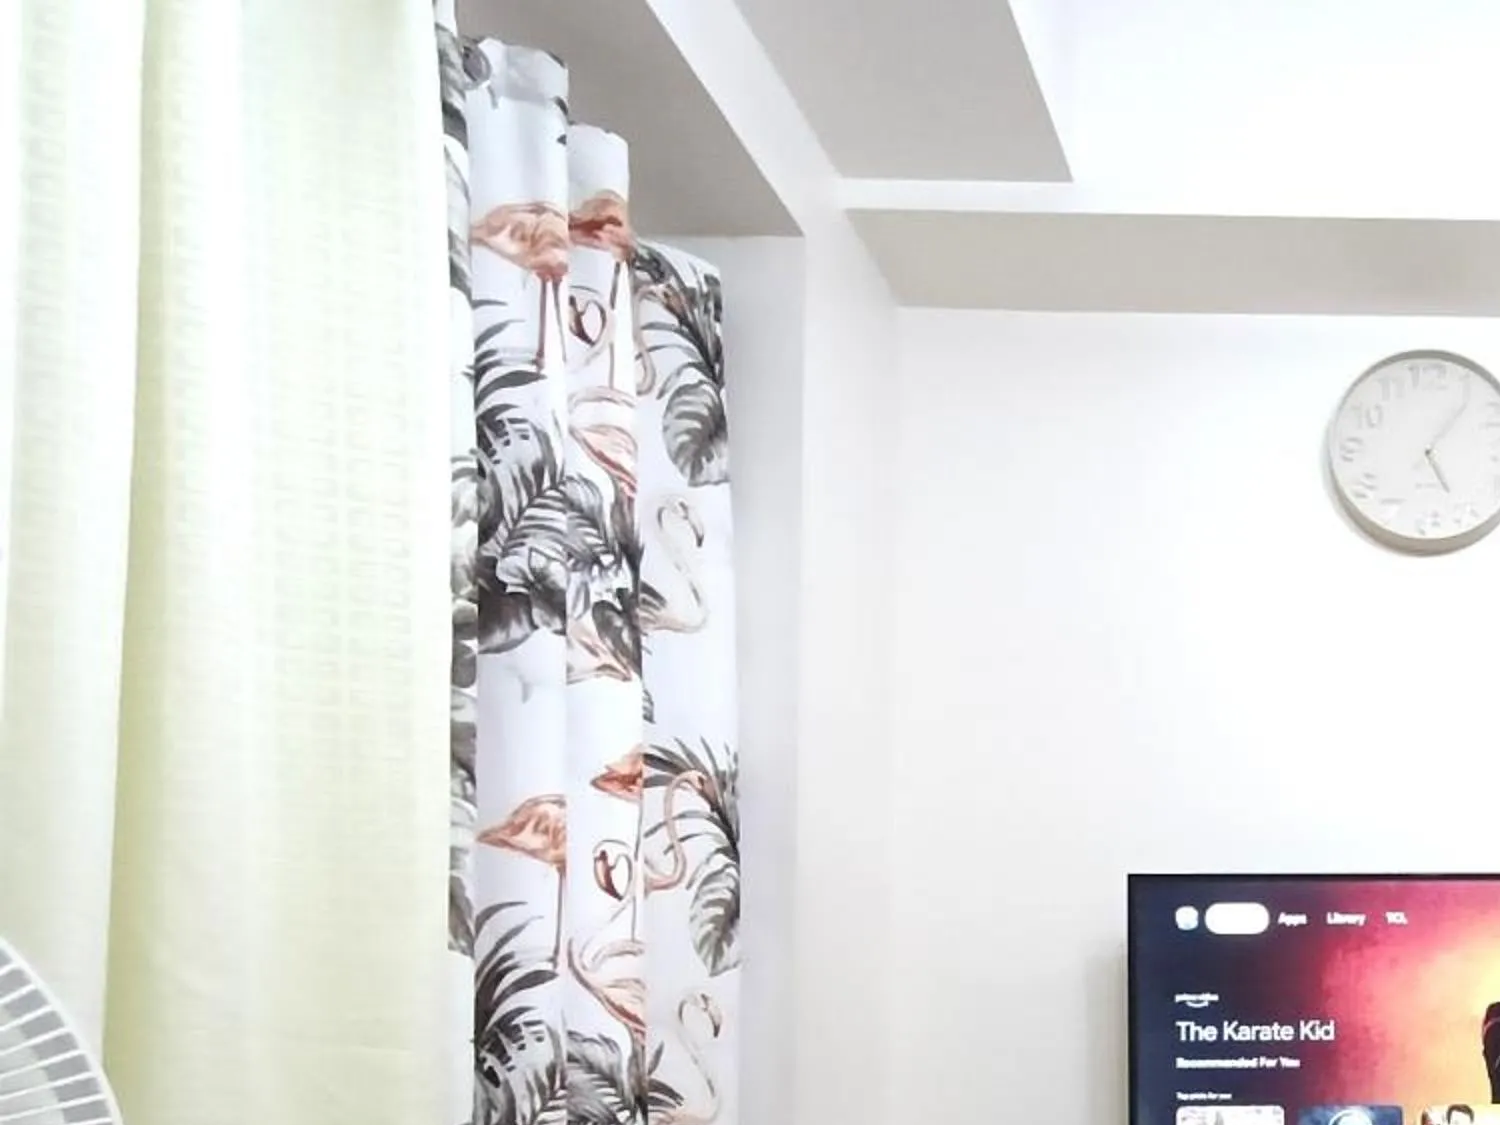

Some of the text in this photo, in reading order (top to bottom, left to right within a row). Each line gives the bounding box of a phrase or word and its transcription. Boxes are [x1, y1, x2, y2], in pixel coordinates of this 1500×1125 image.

[1278, 912, 1307, 927] Apps
[1326, 911, 1366, 926] Library
[1175, 1020, 1335, 1042] The Karate Kid
[1260, 1056, 1277, 1068] For
[1280, 1056, 1300, 1068] You
